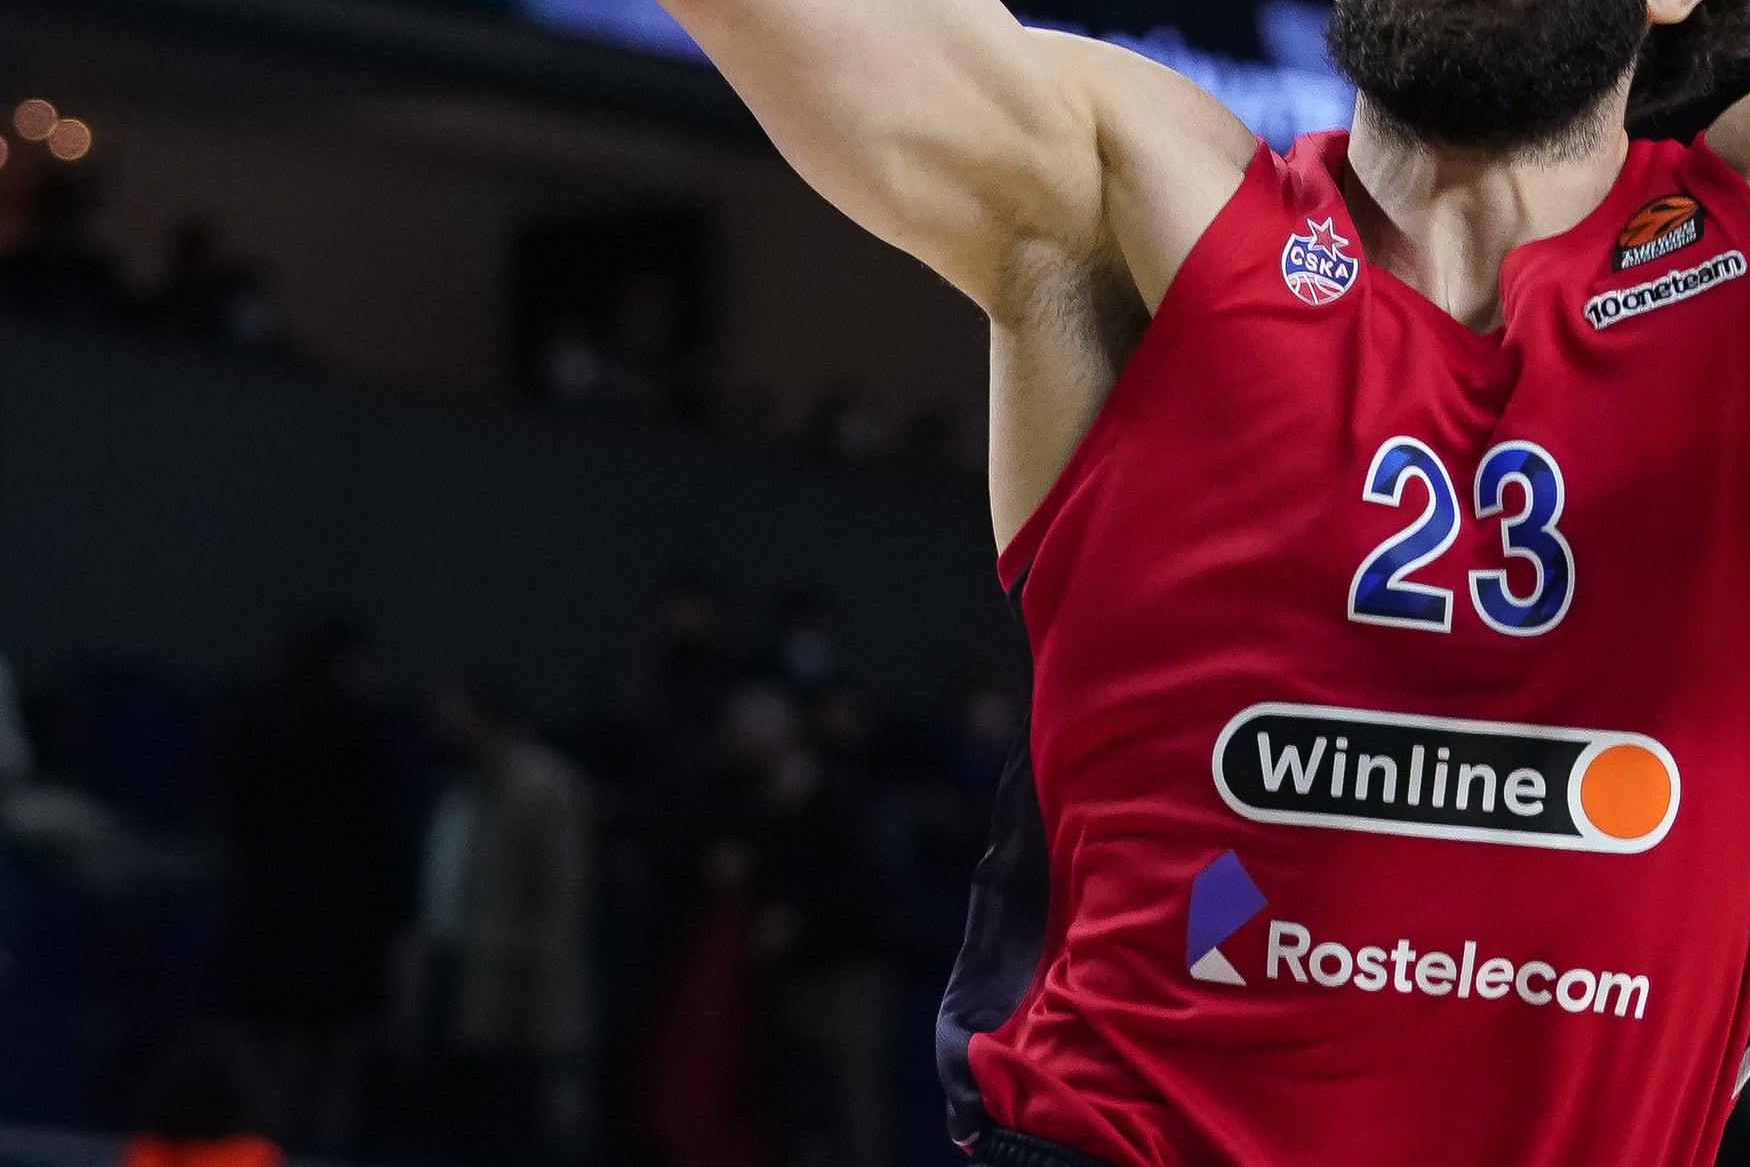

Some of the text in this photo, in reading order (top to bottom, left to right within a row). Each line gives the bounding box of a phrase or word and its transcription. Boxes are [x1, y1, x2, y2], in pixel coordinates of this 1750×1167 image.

[1290, 246, 1349, 279] CSKA
[1347, 435, 1576, 637] 23
[1257, 731, 1547, 817] Winline
[1266, 919, 1651, 1020] Rostelecom
